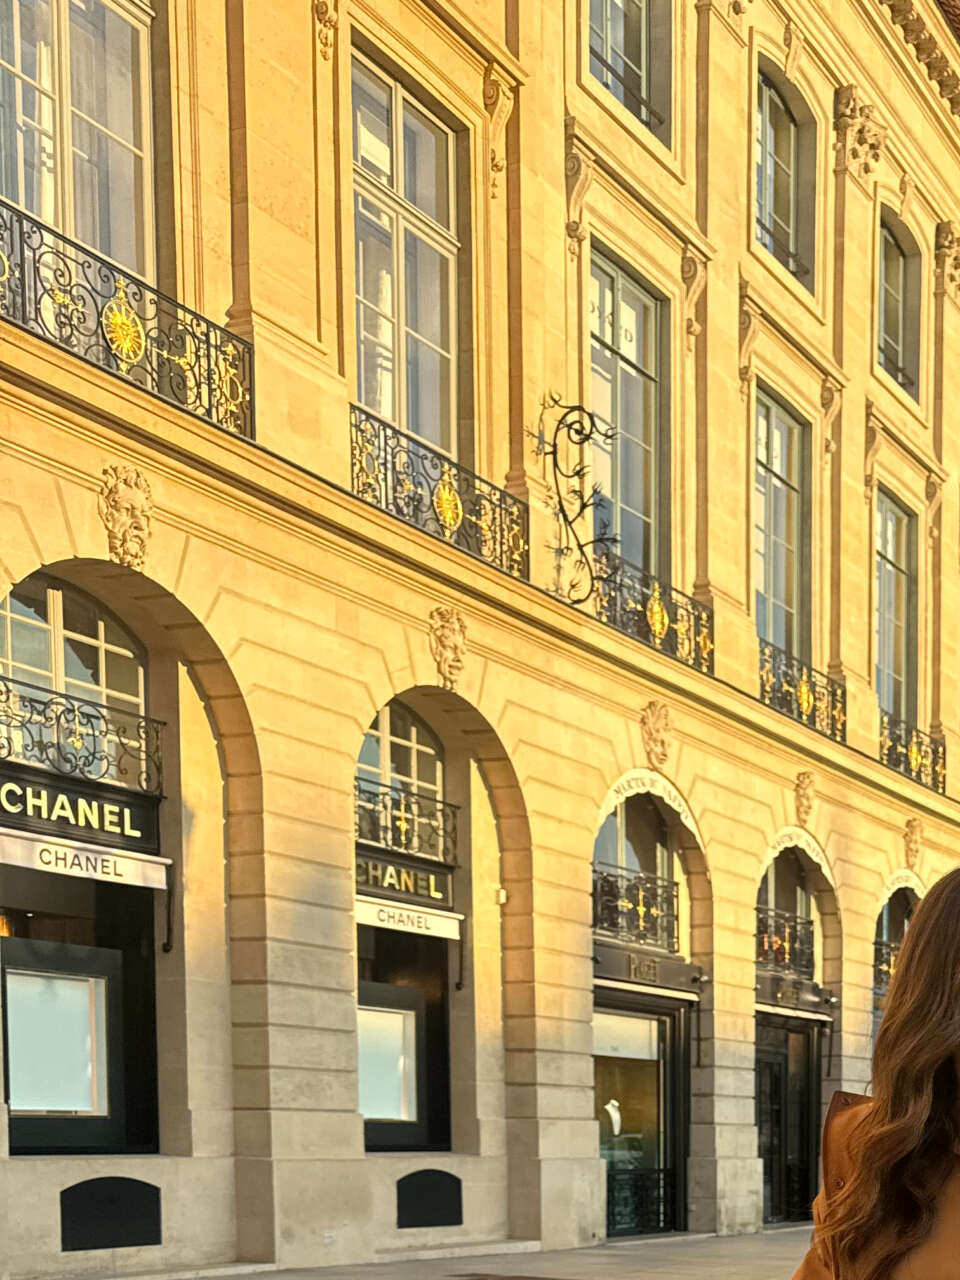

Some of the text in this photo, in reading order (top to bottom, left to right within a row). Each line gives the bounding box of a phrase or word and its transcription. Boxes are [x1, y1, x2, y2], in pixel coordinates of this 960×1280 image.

[0, 782, 142, 838] CHANEL
[39, 848, 124, 877] CHANEL
[356, 858, 443, 899] CHANEL
[377, 908, 431, 931] CHANEL
